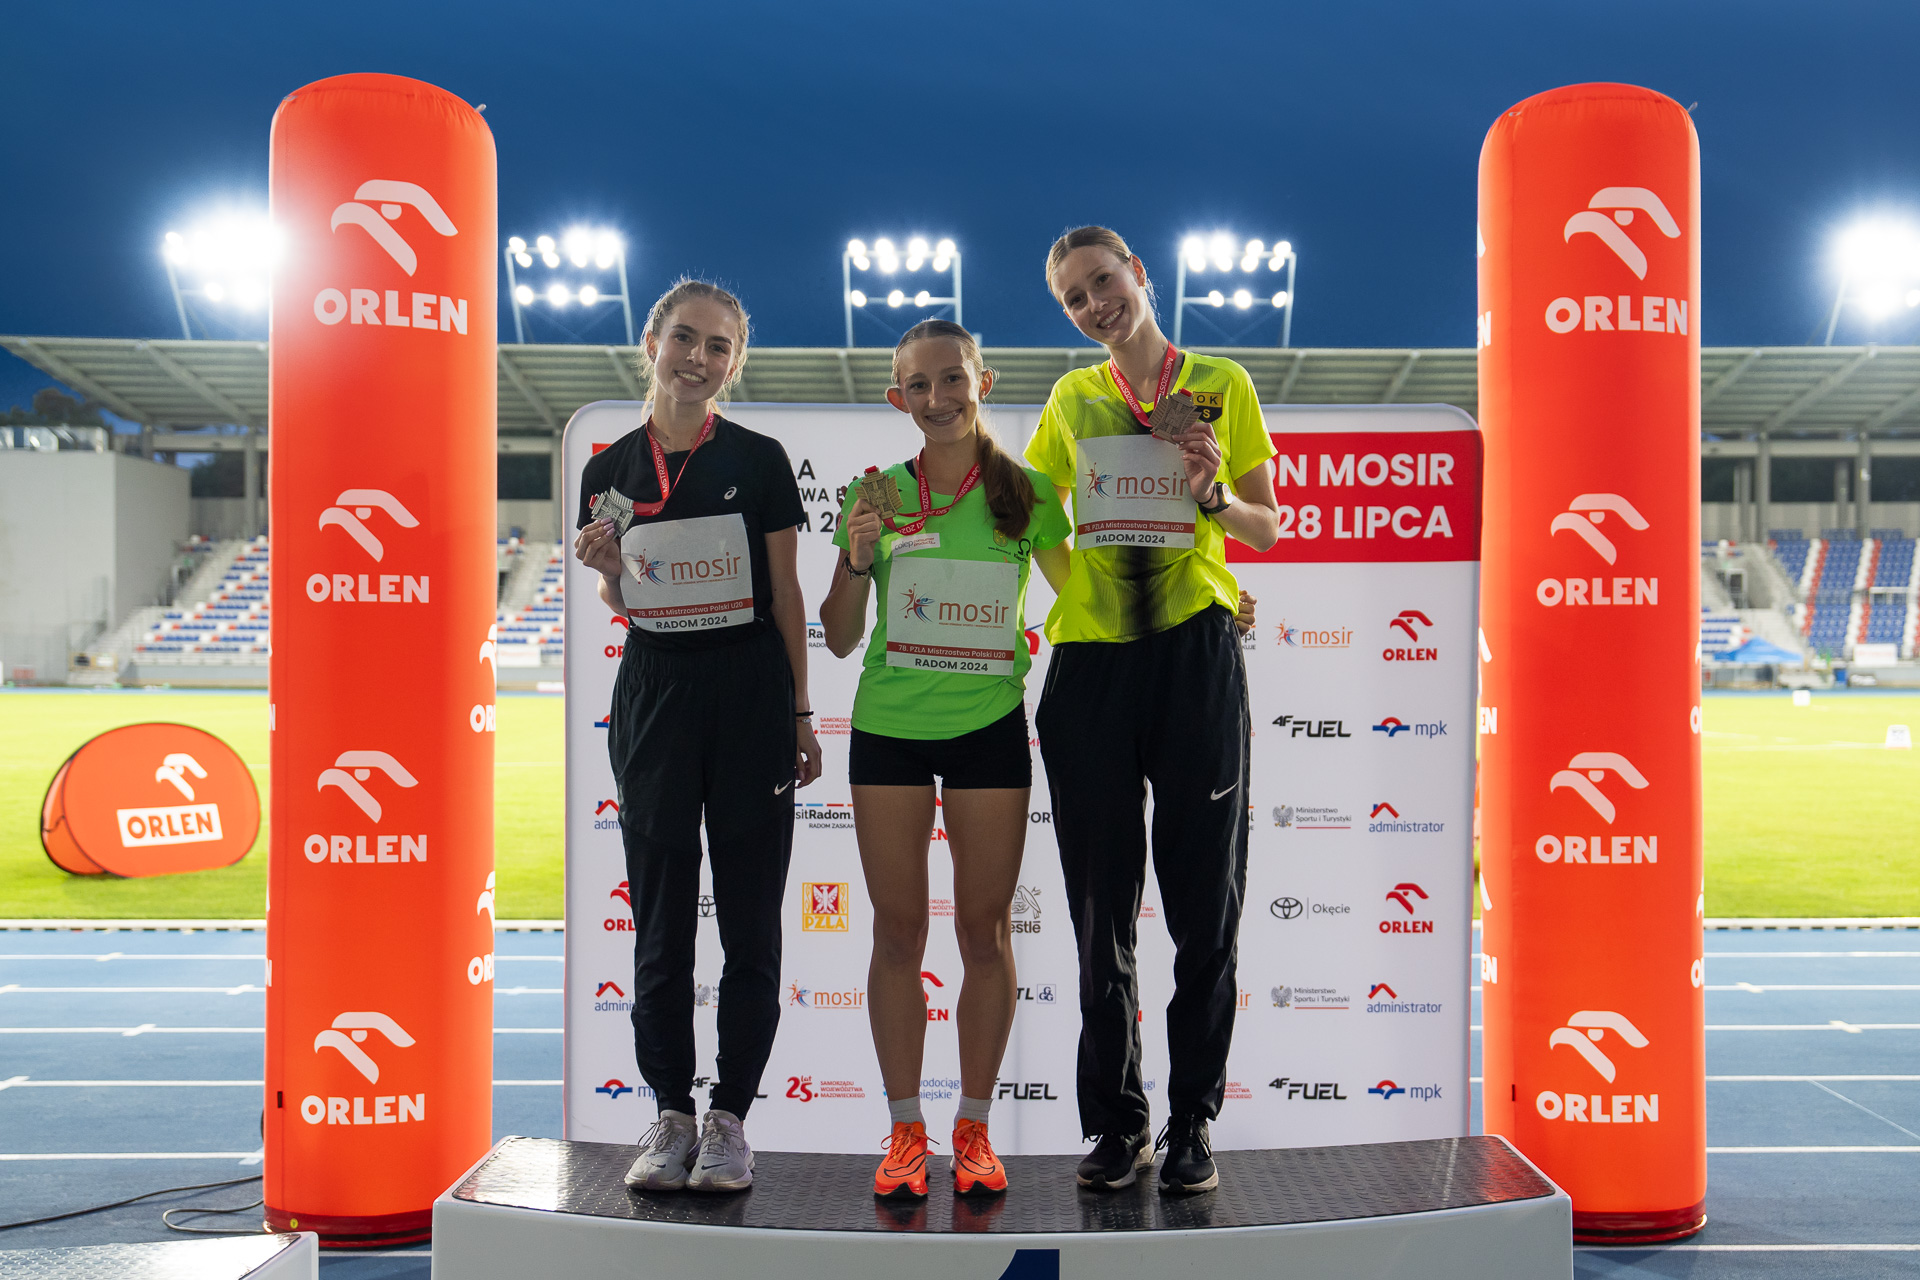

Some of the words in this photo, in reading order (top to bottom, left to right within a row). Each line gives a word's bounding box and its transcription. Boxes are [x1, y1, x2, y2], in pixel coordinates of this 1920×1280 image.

[313, 287, 468, 335] ORLEN
[1545, 295, 1688, 336] ORLEN
[1160, 357, 1173, 395] MISTRZOST
[1319, 453, 1455, 487] MOSIR
[1117, 472, 1188, 496] mosir
[1333, 505, 1454, 539] LIPCA
[1096, 534, 1135, 543] RADOM
[1138, 534, 1165, 543] 2024
[671, 552, 741, 580] mosir
[306, 573, 429, 603] ORLEN
[1536, 577, 1658, 607] ORLEN
[666, 607, 709, 615] Mistrzostwa
[710, 604, 729, 612] Polski
[731, 601, 743, 609] U20
[939, 600, 1009, 624] mosir
[656, 619, 698, 629] RADOM
[701, 616, 728, 626] 2024
[1302, 626, 1353, 645] mosir
[927, 648, 970, 656] Mistrzostwa
[972, 650, 992, 658] Polski
[1382, 648, 1437, 661] ORLEN
[915, 658, 957, 670] RADOM
[960, 662, 988, 671] 2024
[1415, 720, 1447, 739] mpk
[127, 812, 213, 839] ORLEN
[1323, 815, 1352, 823] Turystyki
[1368, 821, 1445, 833] administrator
[304, 834, 427, 863] ORLEN
[1535, 834, 1658, 864] ORLEN
[1312, 903, 1351, 916] Okęcie
[603, 918, 636, 931] ORL
[805, 915, 846, 930] PZLA
[1379, 921, 1433, 934] ORLEN
[814, 988, 865, 1006] mosir
[1294, 995, 1316, 1003] Sportu
[1321, 995, 1350, 1003] Turystyki
[1366, 1001, 1442, 1013] administrator
[998, 1083, 1058, 1100] FUEL
[1410, 1084, 1442, 1101] mpk
[300, 1093, 425, 1125] ORLEN
[1536, 1090, 1659, 1123] ORLEN
